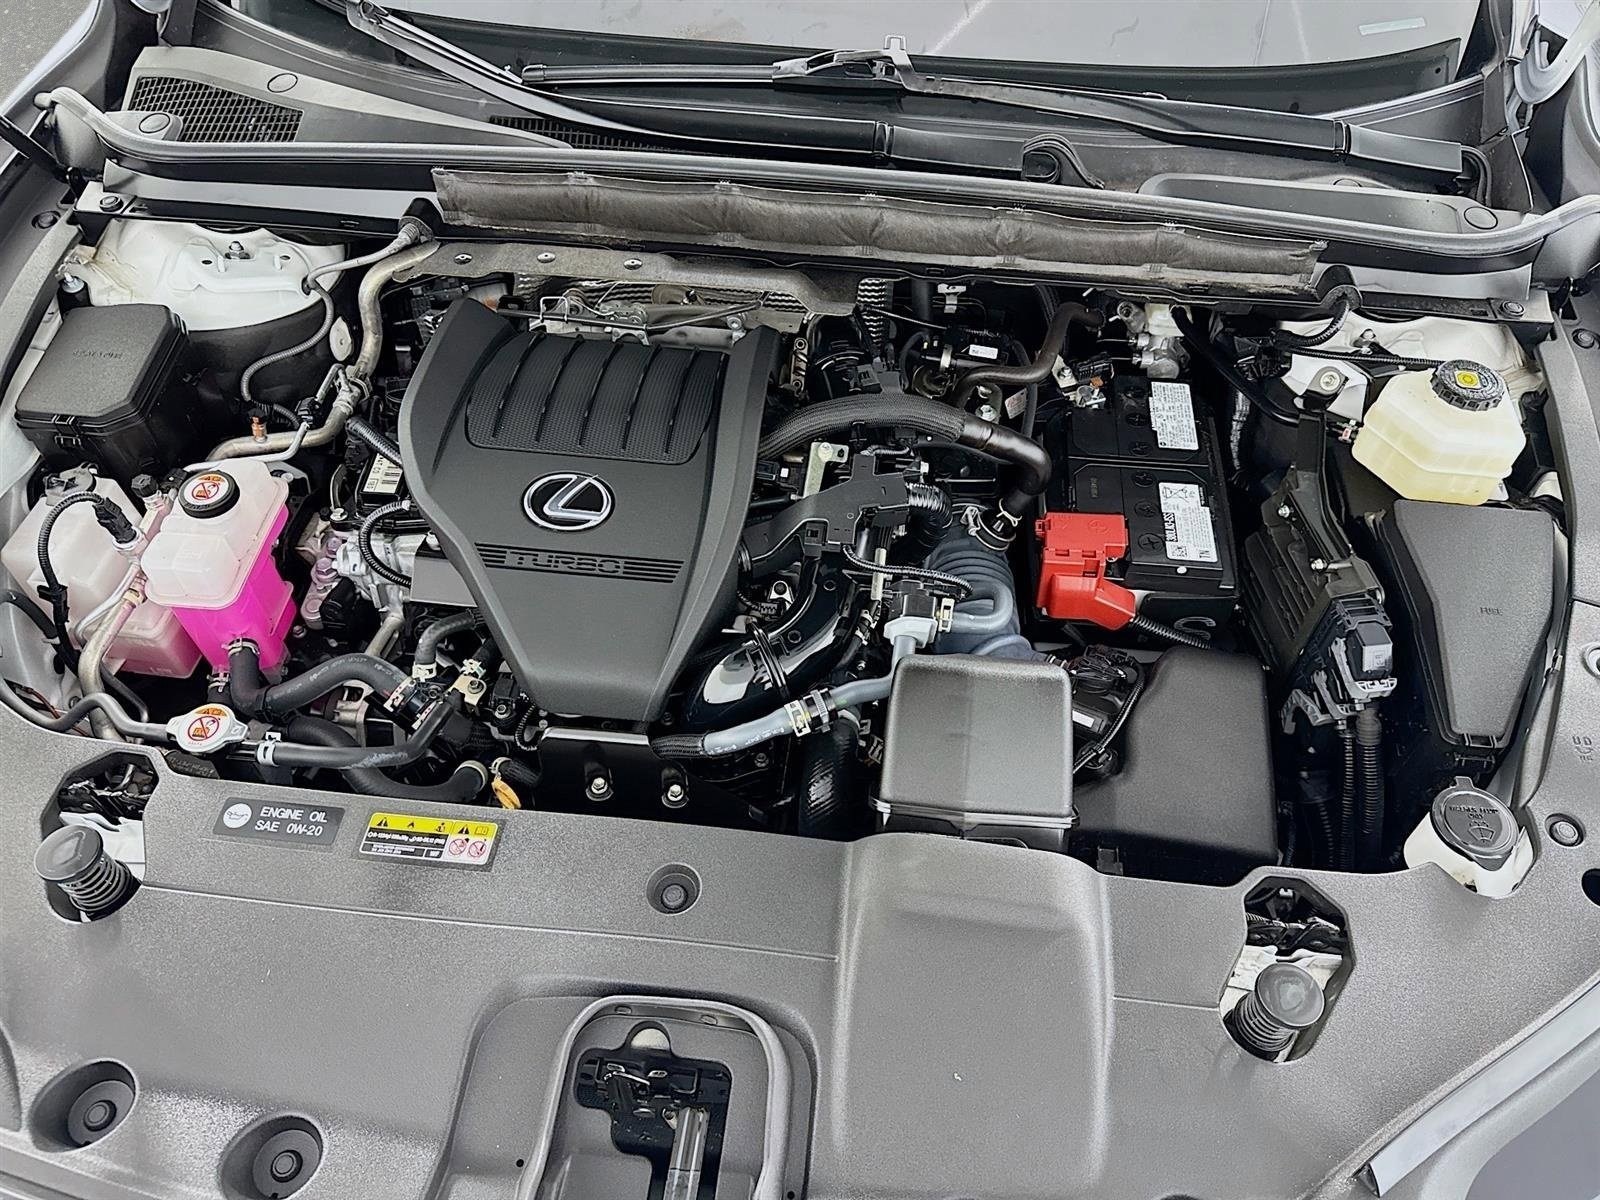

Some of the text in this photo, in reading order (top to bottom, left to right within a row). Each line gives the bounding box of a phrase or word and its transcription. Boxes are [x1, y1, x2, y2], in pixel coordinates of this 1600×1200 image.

[505, 551, 624, 575] TURBO
[260, 806, 328, 823] ENGINE OIL
[254, 820, 324, 837] SAE 0W-20
